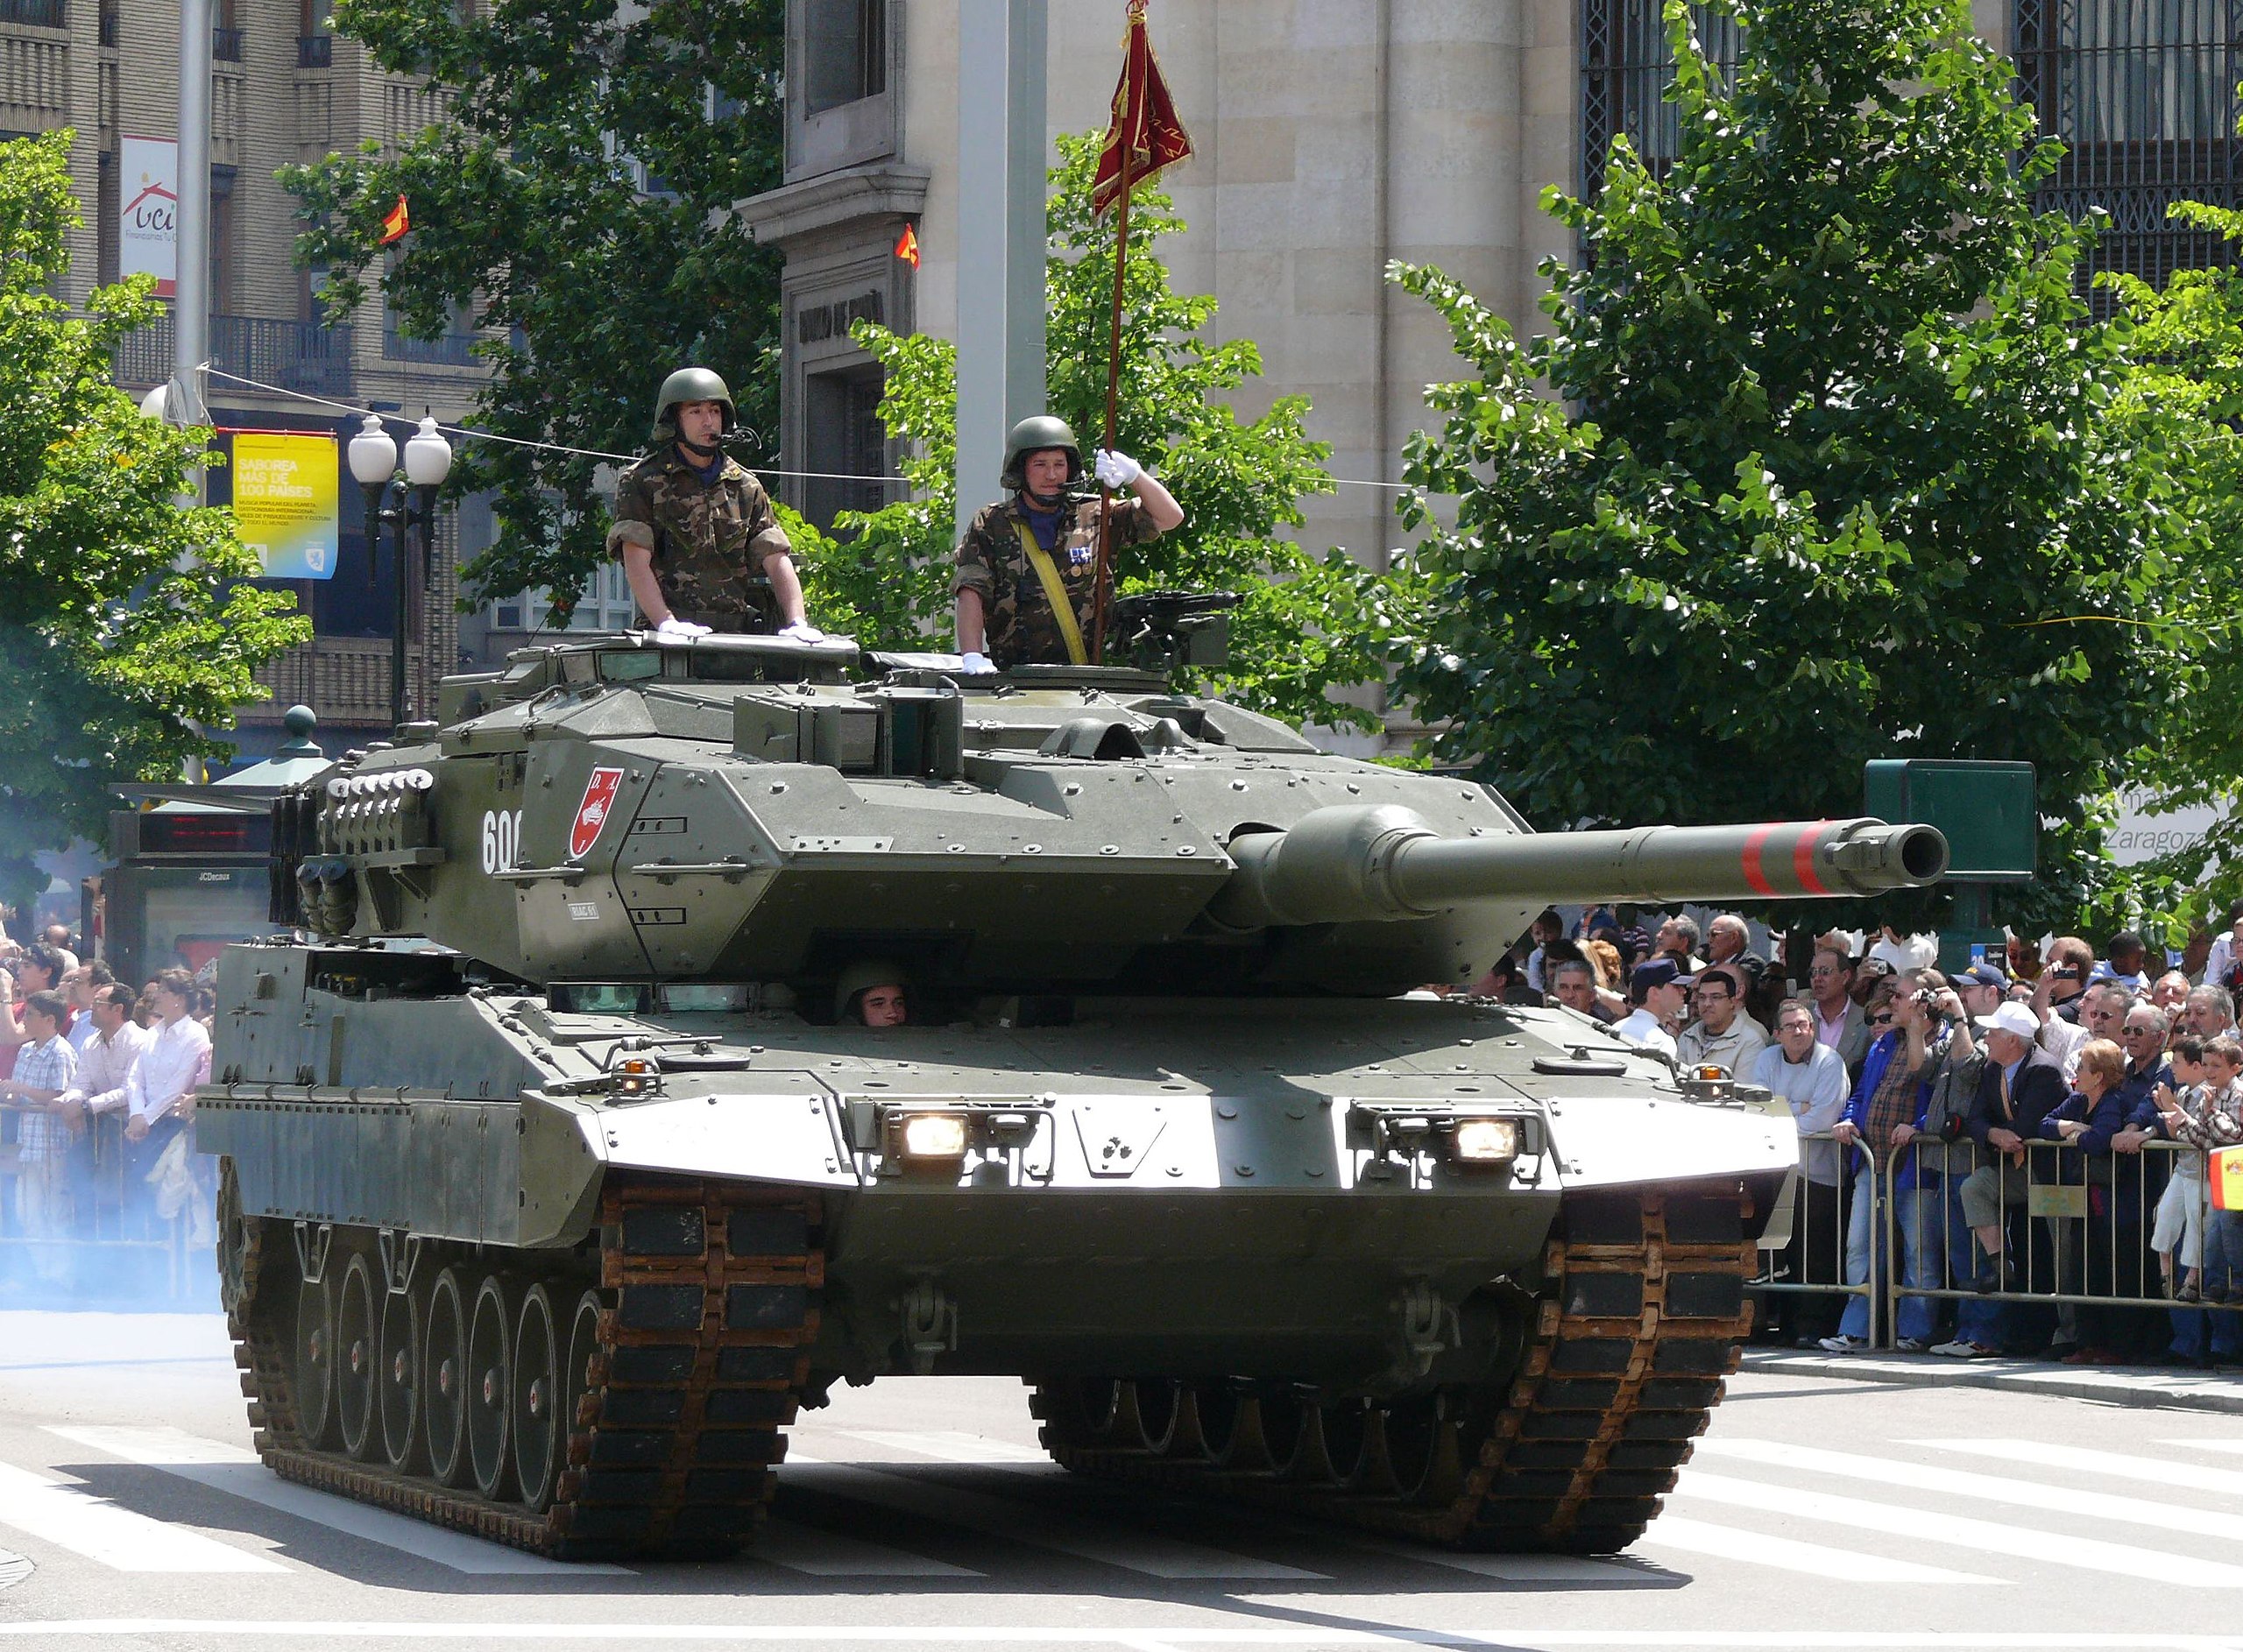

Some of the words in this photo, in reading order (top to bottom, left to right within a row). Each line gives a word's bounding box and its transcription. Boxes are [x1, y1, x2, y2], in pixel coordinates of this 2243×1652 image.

[136, 203, 174, 230] uci
[238, 458, 298, 472] SABOREA
[271, 473, 289, 485] DE
[238, 484, 265, 497] 100
[591, 773, 602, 789] D.
